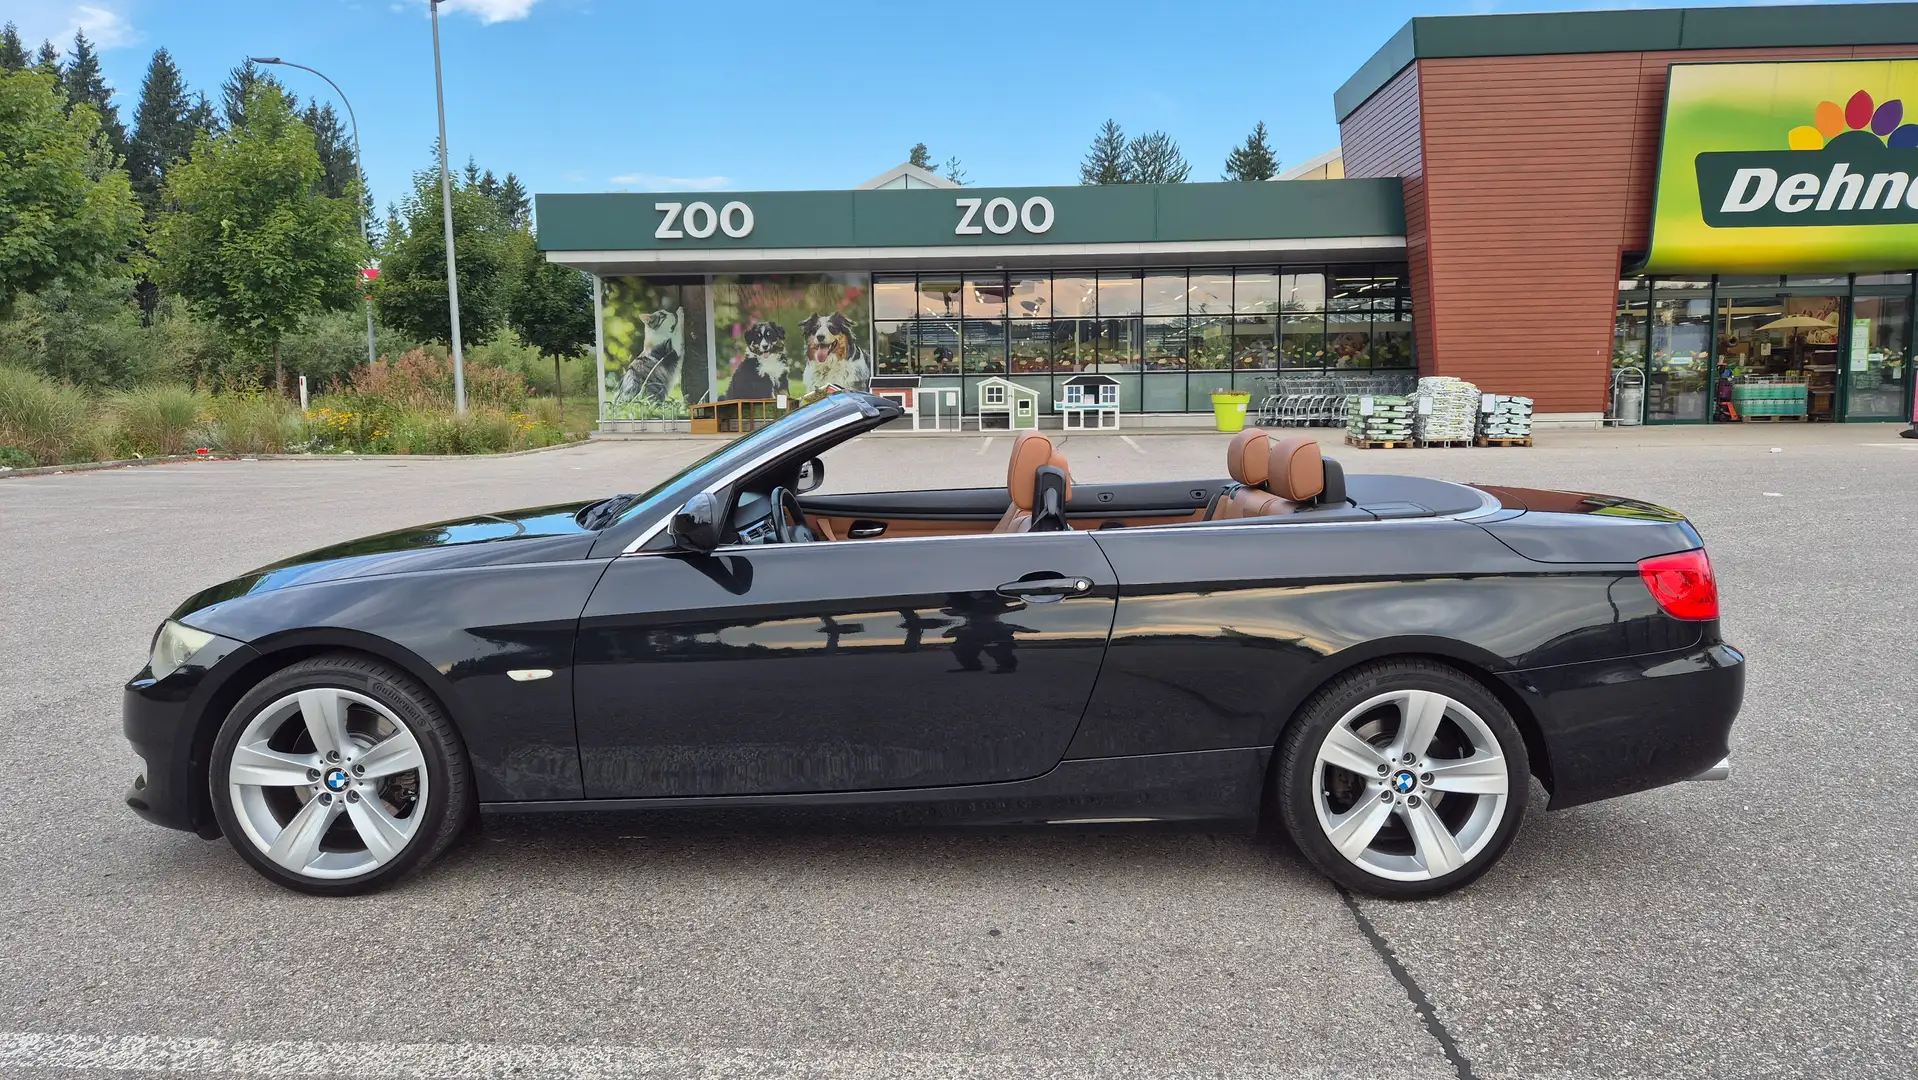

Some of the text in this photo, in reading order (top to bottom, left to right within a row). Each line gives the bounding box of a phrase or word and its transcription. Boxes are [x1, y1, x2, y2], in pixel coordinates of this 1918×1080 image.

[1720, 163, 1918, 213] Dehn
[655, 201, 754, 239] ZOO
[955, 196, 1055, 234] ZOO
[372, 682, 421, 721] Continental
